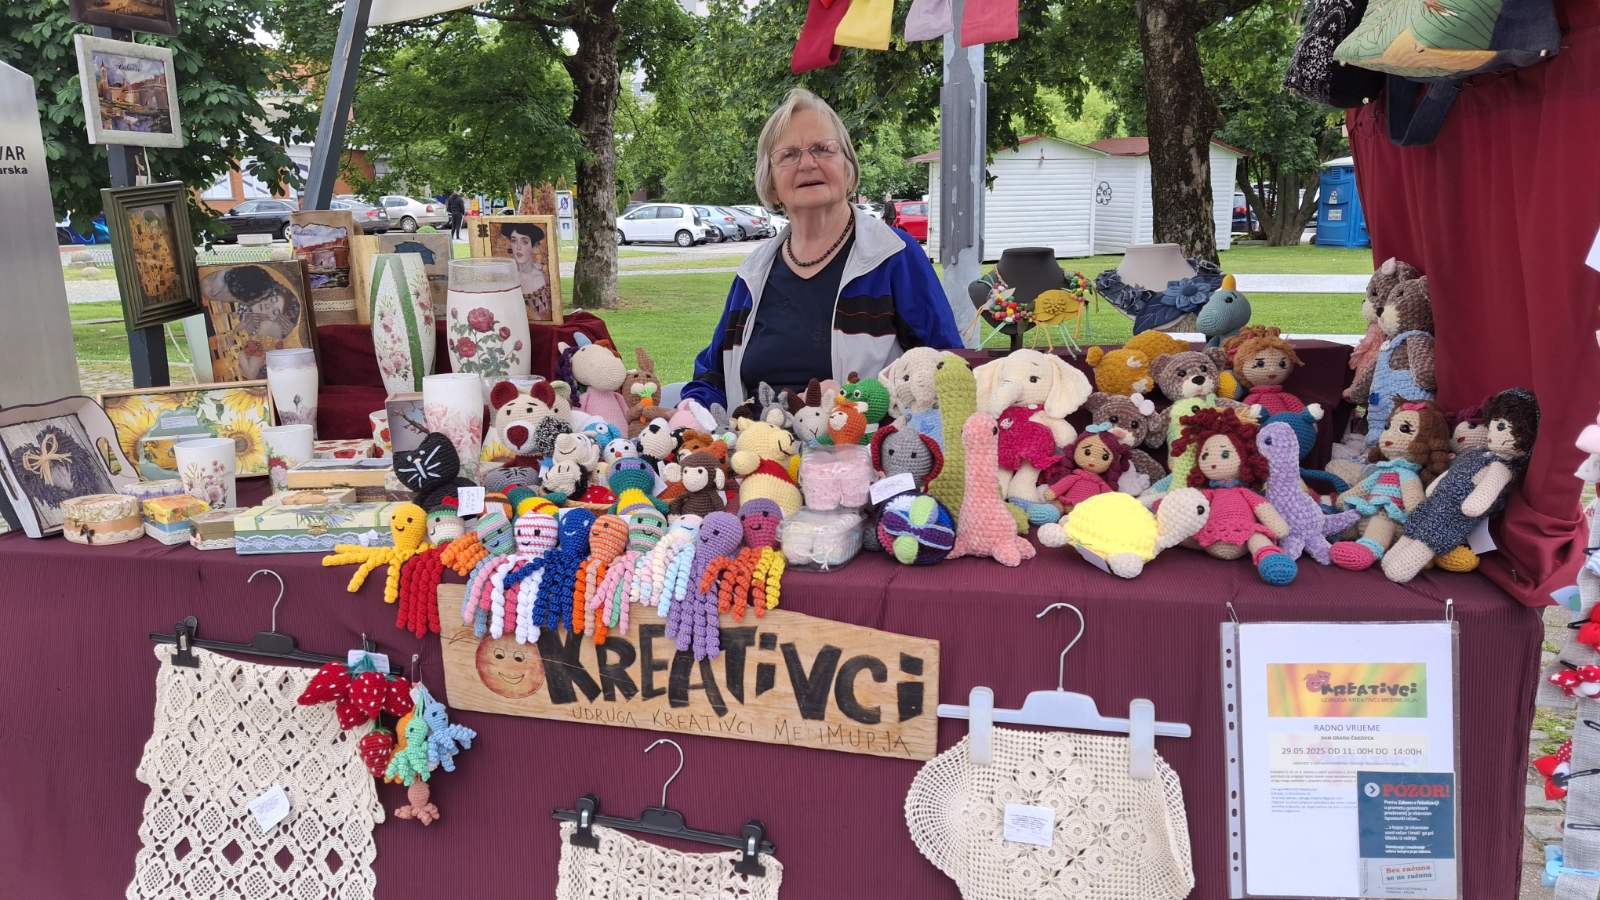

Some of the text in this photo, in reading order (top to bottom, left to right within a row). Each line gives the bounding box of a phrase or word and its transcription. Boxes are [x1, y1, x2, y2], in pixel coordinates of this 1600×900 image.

[571, 706, 638, 728] UDRUGA
[1314, 724, 1382, 732] RADNO VRIJEME
[1328, 747, 1340, 755] OD
[1375, 747, 1389, 755] DO
[1382, 783, 1451, 799] POZOR!
